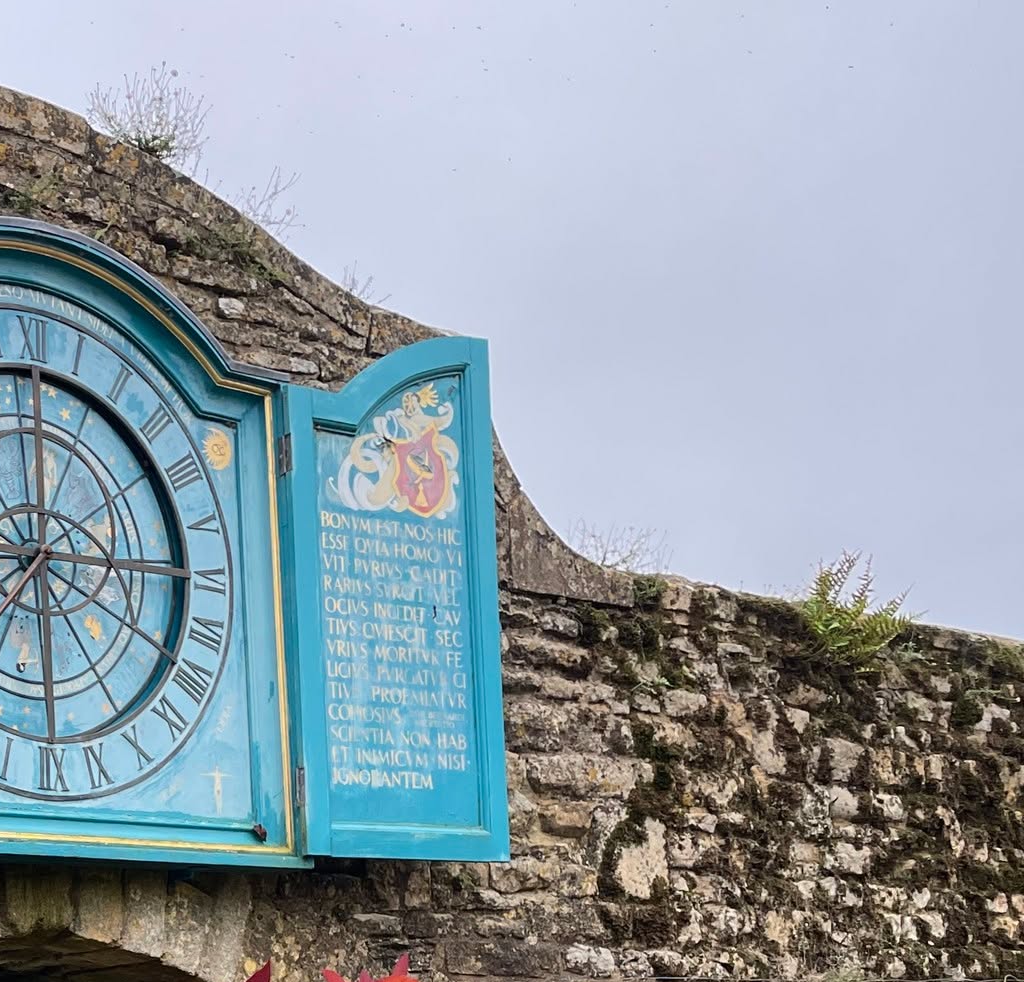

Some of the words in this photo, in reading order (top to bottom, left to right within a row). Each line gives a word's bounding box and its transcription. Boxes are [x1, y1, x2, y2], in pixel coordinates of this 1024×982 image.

[16, 315, 48, 364] XII
[71, 333, 86, 377] I
[106, 362, 134, 405] II
[186, 510, 221, 535] V
[403, 522, 434, 543] NOS
[437, 527, 462, 546] HIC
[394, 543, 441, 564] HOMO
[324, 595, 369, 617] OCIVS
[435, 629, 464, 648] SEC
[446, 651, 464, 669] FE
[120, 723, 156, 771] X
[436, 732, 467, 751] HAB
